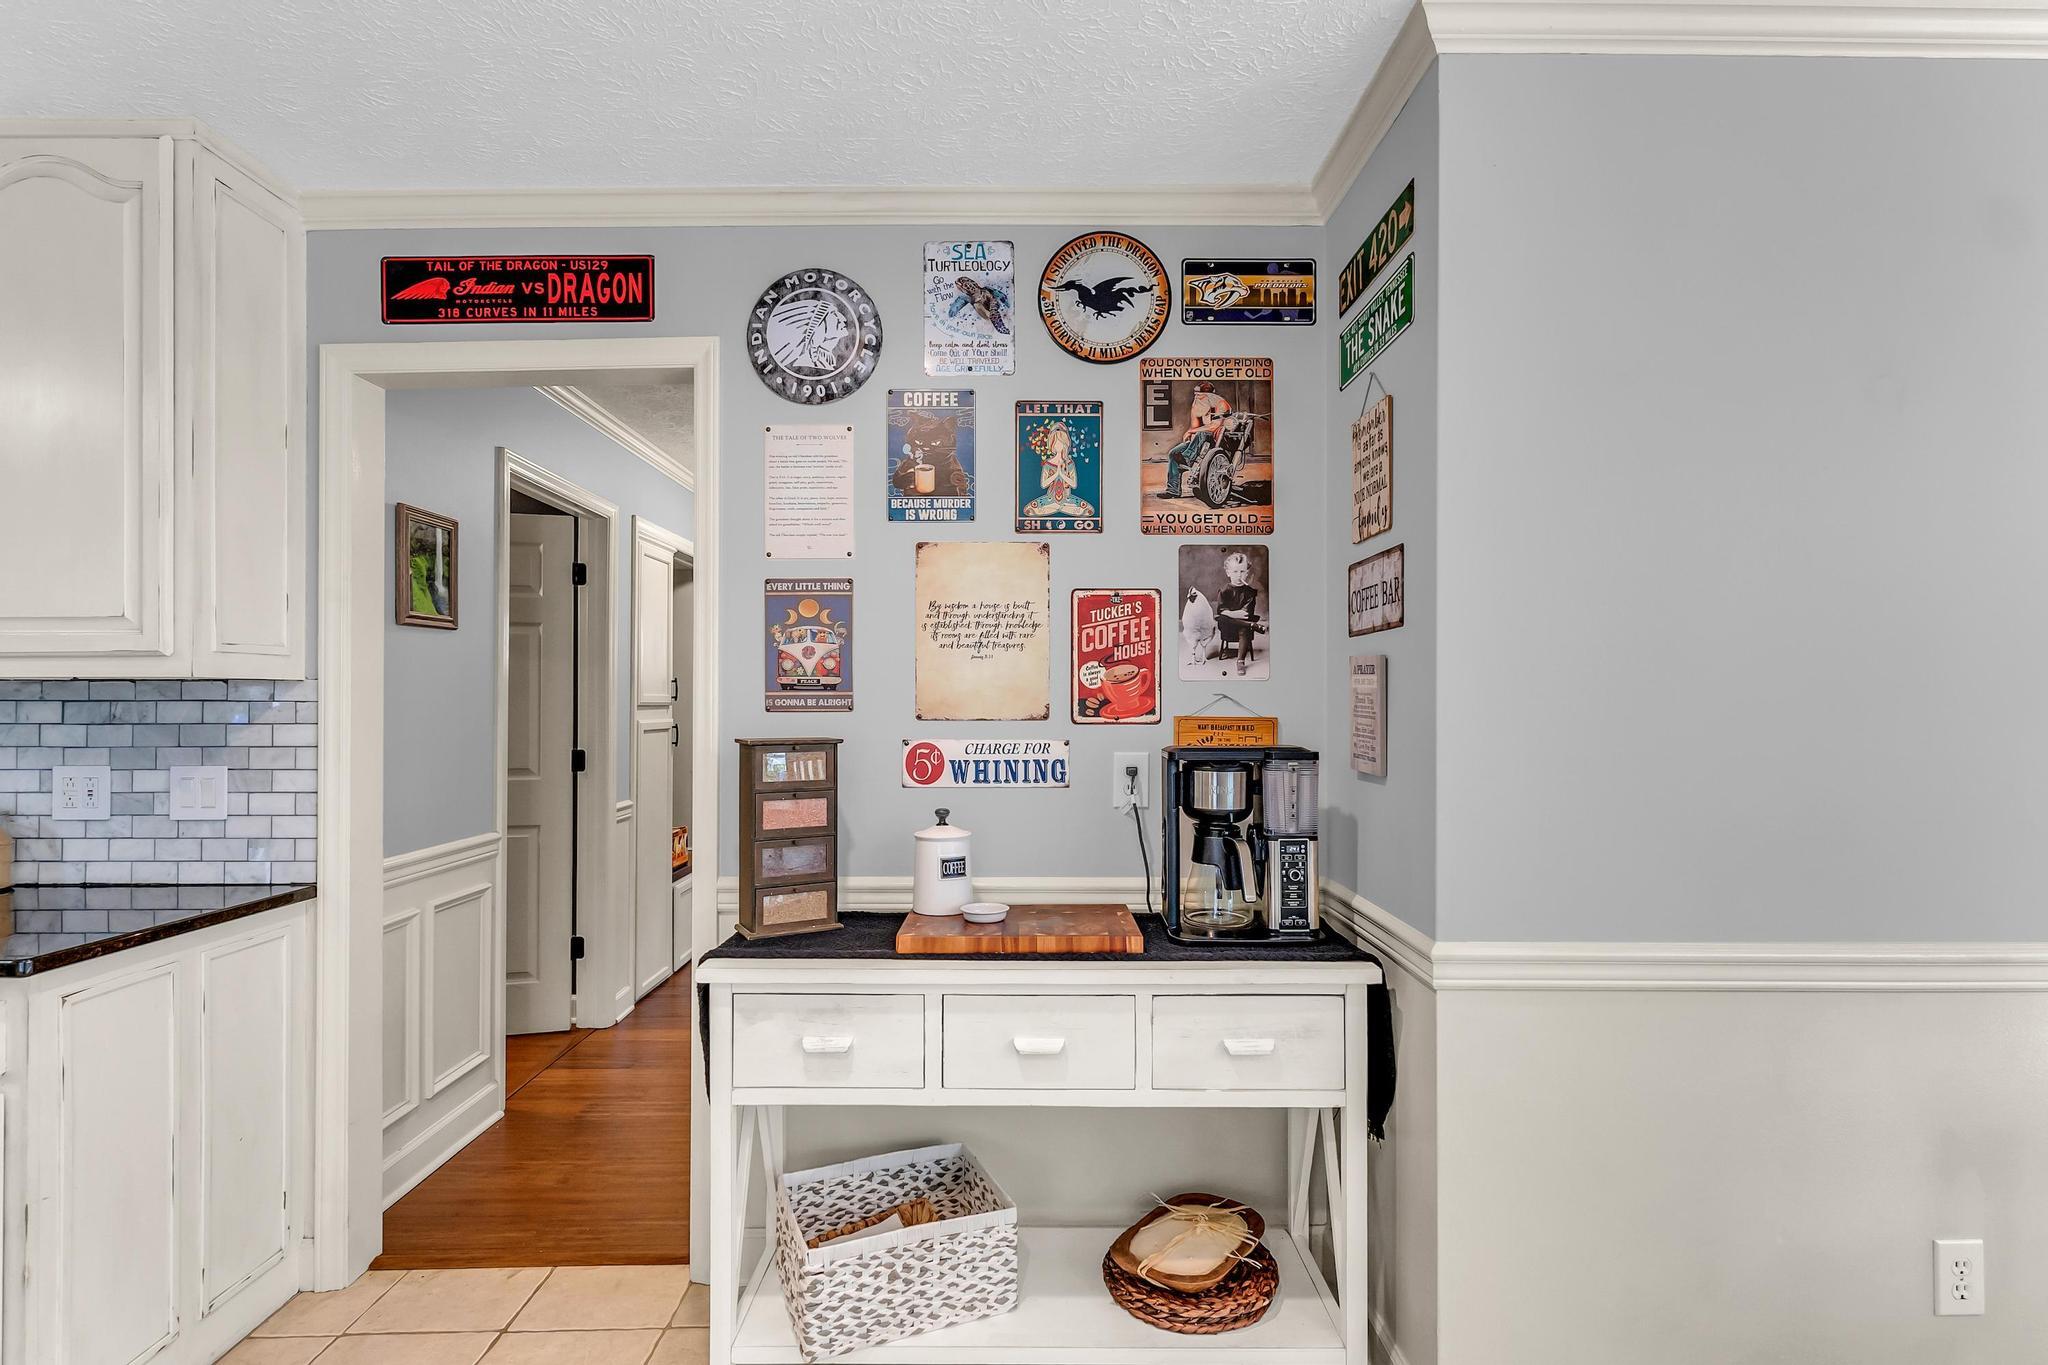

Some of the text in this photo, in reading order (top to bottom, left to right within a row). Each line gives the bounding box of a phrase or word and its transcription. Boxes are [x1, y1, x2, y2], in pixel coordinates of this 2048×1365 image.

[951, 243, 987, 260] SEA
[1049, 236, 1097, 277] SURVIVED
[1100, 235, 1124, 249] THE
[1125, 241, 1161, 278] DRAGON
[426, 260, 608, 272] TAIL OF THE DRAGON US129
[927, 258, 1011, 272] TURTLEOLOGY
[1340, 209, 1397, 312] EXIT 420
[933, 275, 945, 285] Go
[453, 272, 643, 304] Indian VS DRAGON
[943, 282, 955, 291] the
[934, 292, 954, 303] Flow
[438, 306, 598, 318] 318 CURVES IN 11 MILES
[751, 289, 779, 374] INDIAN
[784, 272, 877, 374] MOTORCYCLE
[1043, 301, 1056, 318] 318
[1050, 320, 1085, 353] CURVES
[1100, 342, 1134, 358] MILES
[1135, 317, 1161, 347] DEALS
[1154, 295, 1167, 316] GAP
[1345, 281, 1406, 369] THE SNAKE
[1141, 359, 1272, 367] YOU DON'T STOP RIDING
[1142, 368, 1271, 377] WHEN YOU GET OLD
[791, 381, 838, 397] 1901
[903, 391, 959, 407] COFFEE
[1025, 404, 1092, 414] LET THAT
[891, 499, 971, 509] BECAUSE MURDER
[905, 509, 957, 520] IS WRONG
[1157, 514, 1258, 524] YOU GET OLD
[1074, 521, 1094, 530] GO
[1143, 525, 1272, 533] WHEN YOU STOP RIDING
[767, 582, 850, 590] EVERY LITTLE THING
[1351, 577, 1400, 615] COFFEE BAR
[929, 600, 941, 613] By
[944, 601, 969, 612] wisdom
[979, 601, 1000, 611] house
[1004, 603, 1010, 612] is
[1012, 601, 1035, 609] built
[1090, 601, 1142, 622] TUCKER'S
[925, 611, 1037, 621] and through understanding it
[921, 622, 927, 631] is
[974, 621, 1002, 632] through
[1005, 621, 1042, 633] knowledge
[941, 632, 961, 640] rooms
[979, 630, 999, 641] filled
[1002, 631, 1017, 640] with
[1081, 617, 1151, 652] COFFEE
[939, 641, 954, 649] and
[957, 641, 989, 653] beautiful
[1114, 641, 1151, 661] HOUSE
[912, 743, 1051, 781] 5¢ CHARGE FOR
[949, 758, 1067, 784] WHINING
[943, 861, 965, 875] COFFEE
